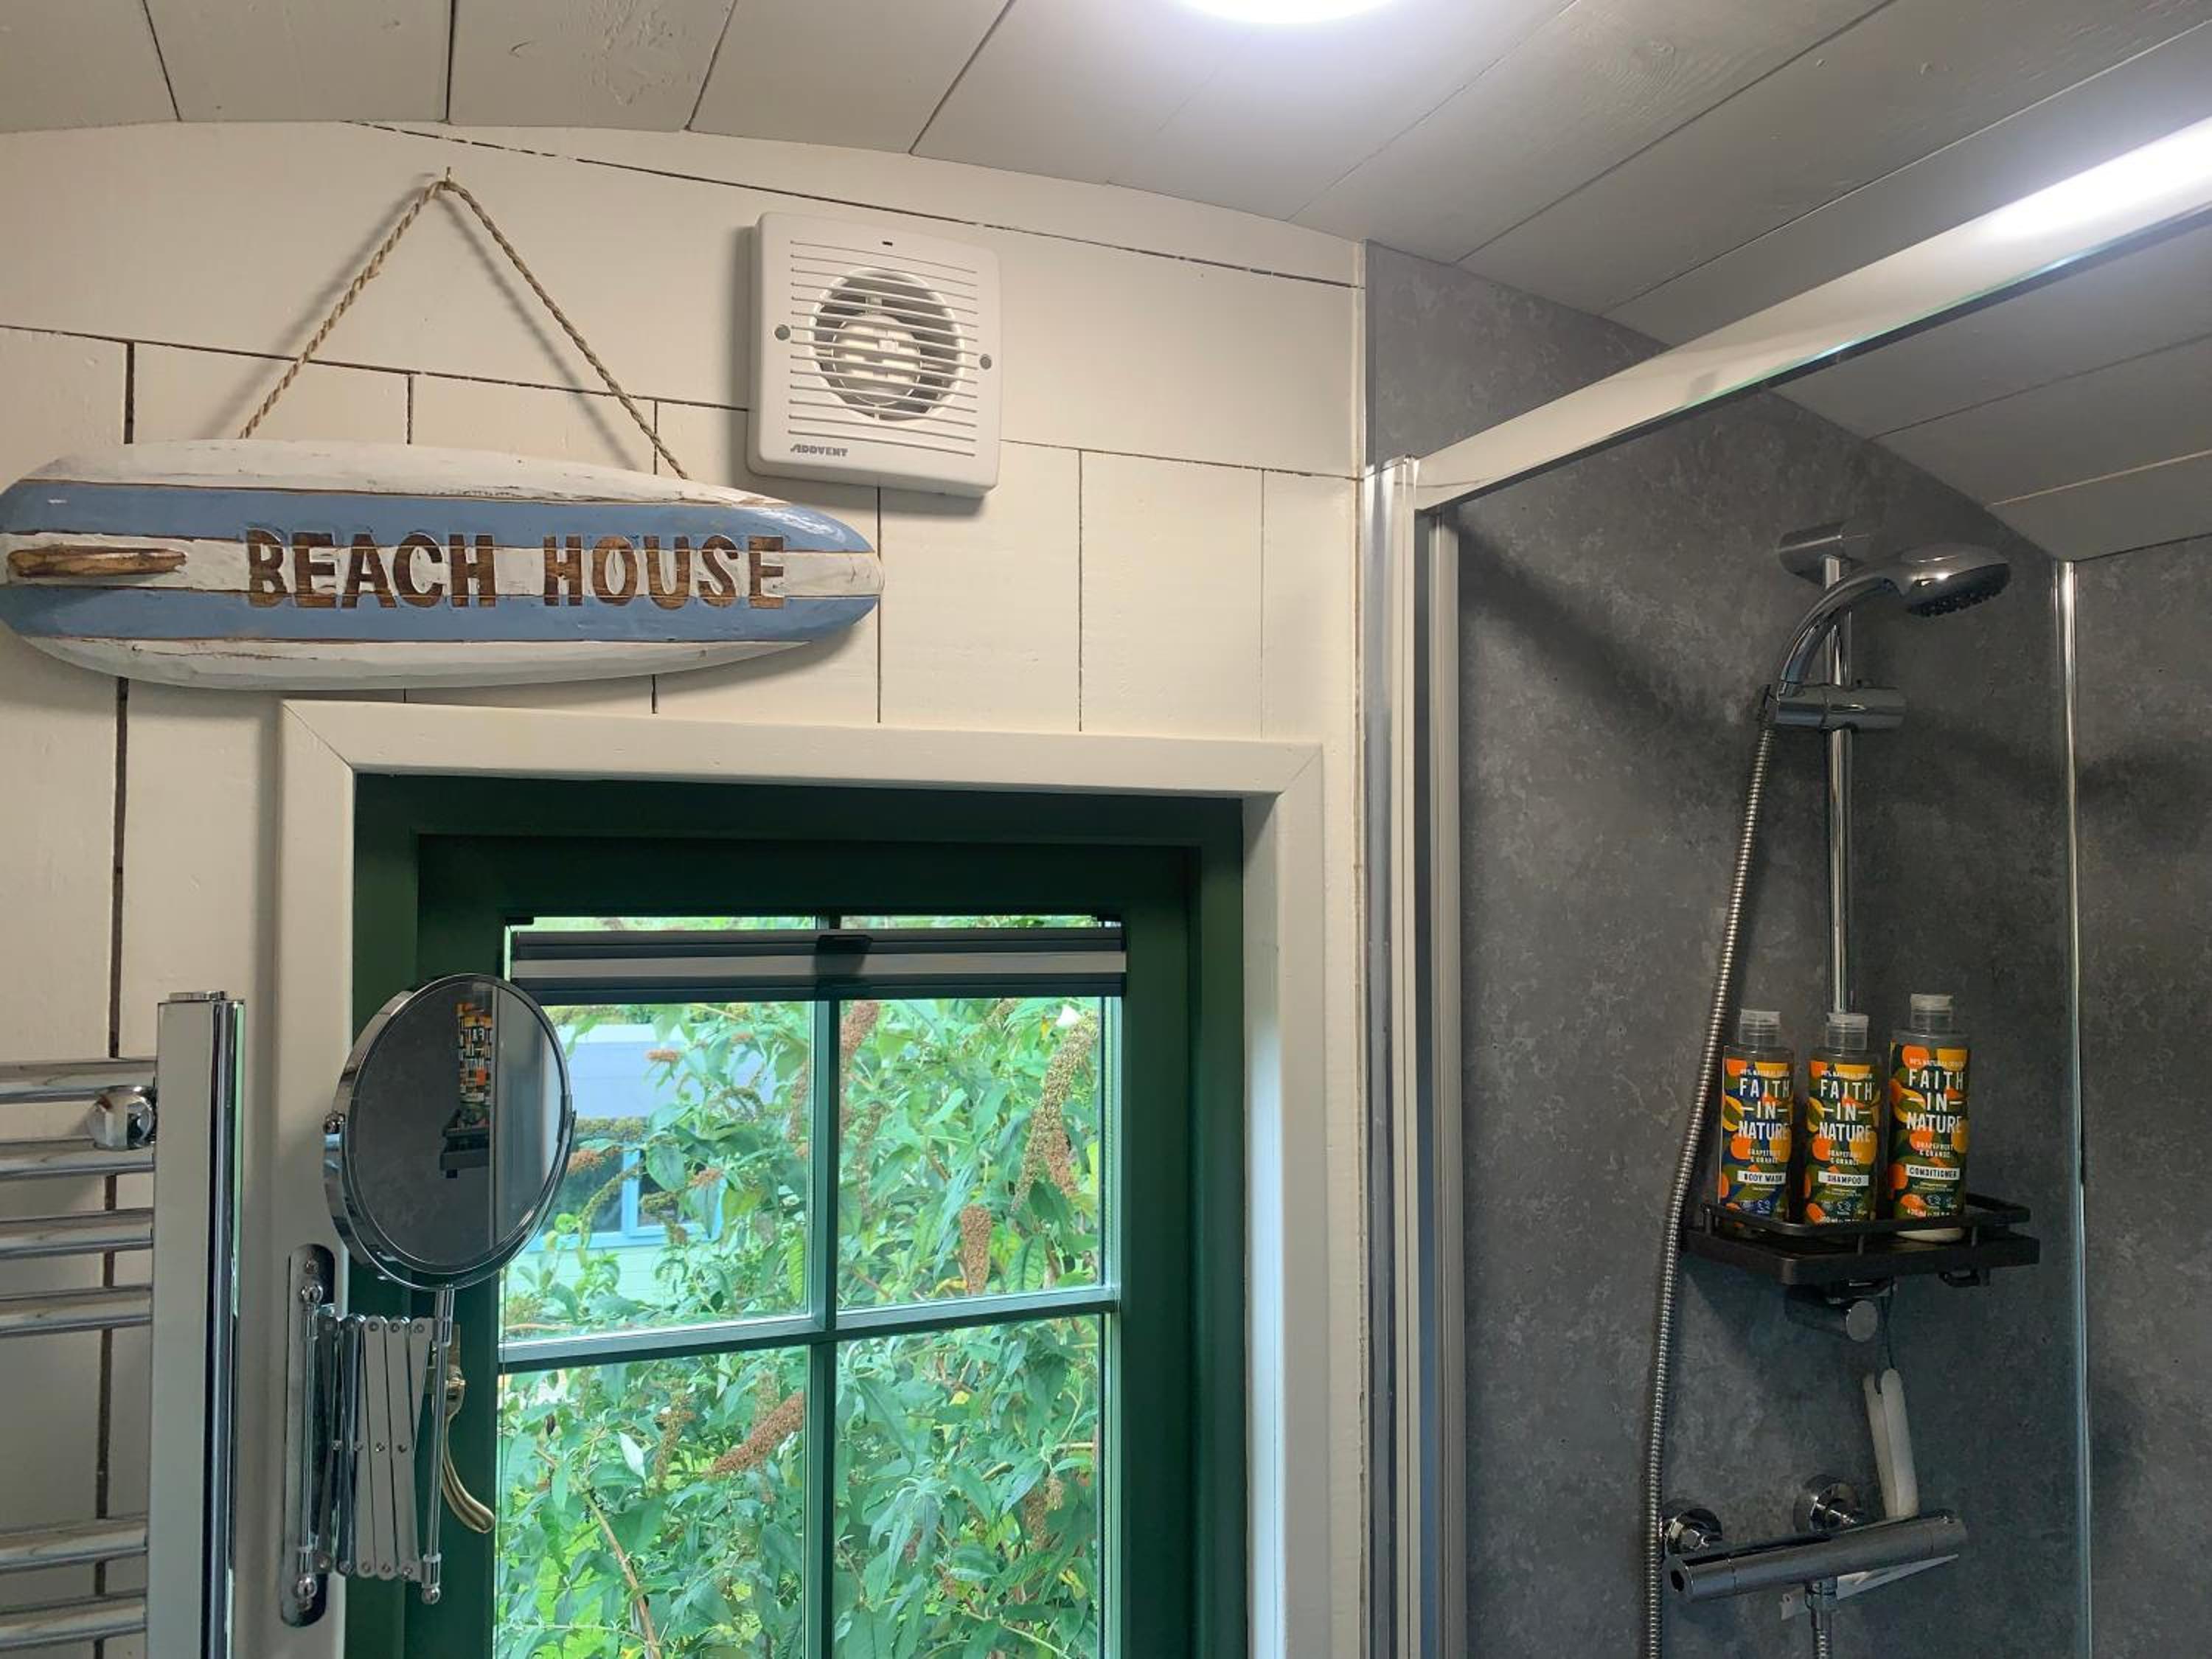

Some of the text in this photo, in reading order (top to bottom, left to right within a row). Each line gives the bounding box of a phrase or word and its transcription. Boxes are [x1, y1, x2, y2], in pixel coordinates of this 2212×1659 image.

[790, 444, 848, 456] ADDVENT
[245, 527, 785, 611] BEACH HOUSE
[1740, 1077, 1790, 1099] FAITH
[1820, 1079, 1872, 1101] FAITH
[1909, 1068, 1964, 1091] FAITH
[1738, 1120, 1790, 1141] NATURE
[1819, 1121, 1872, 1143] NATURE
[1906, 1111, 1962, 1133] NATURE
[1744, 1172, 1763, 1182] BODY
[1827, 1175, 1863, 1184] SHAMPOO
[1909, 1166, 1957, 1179] CONDITIONER
